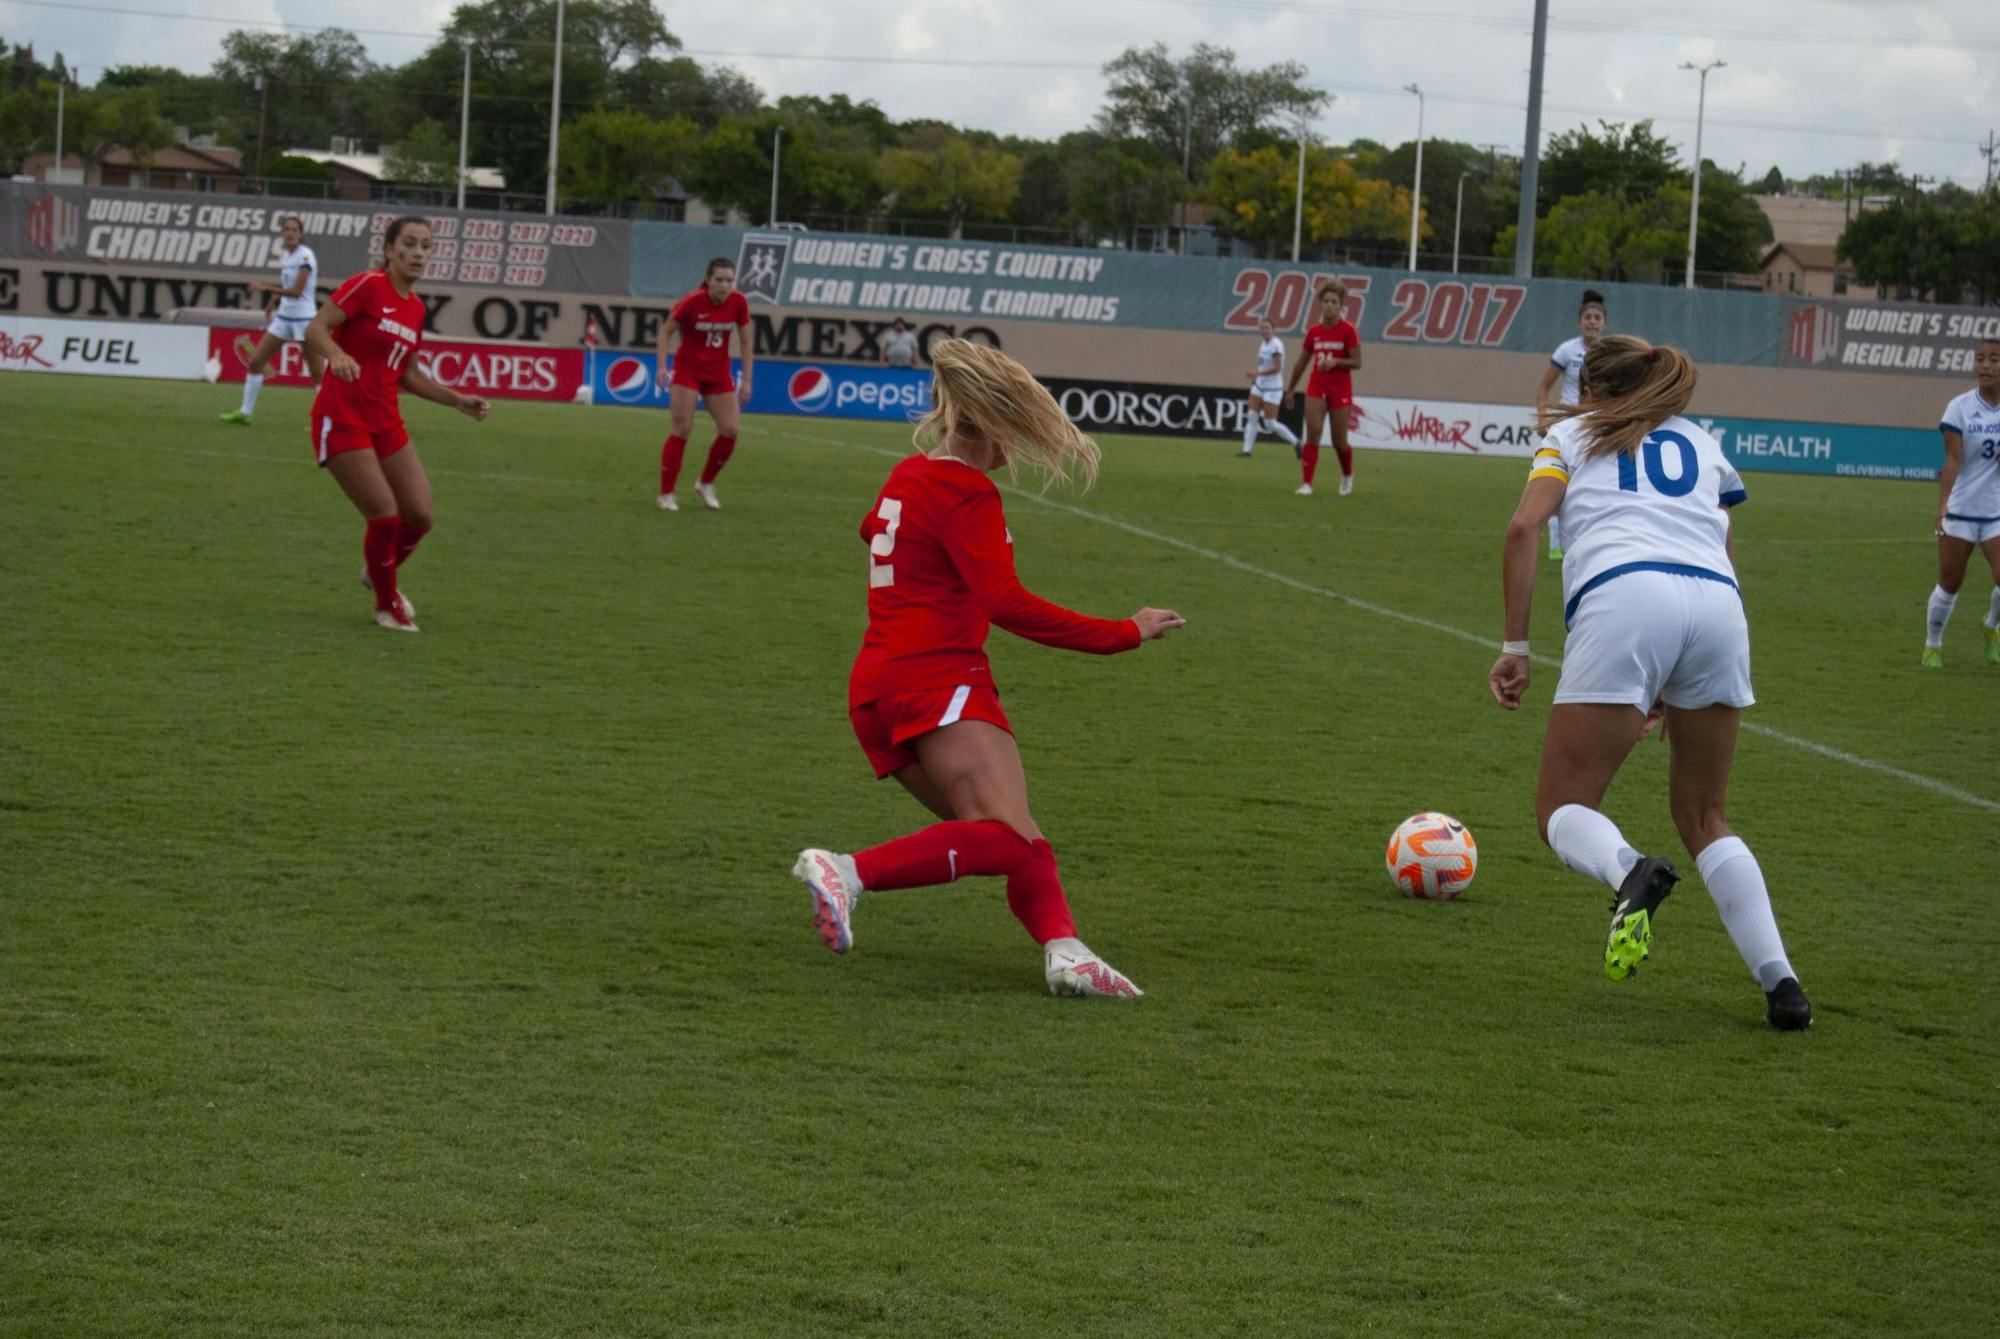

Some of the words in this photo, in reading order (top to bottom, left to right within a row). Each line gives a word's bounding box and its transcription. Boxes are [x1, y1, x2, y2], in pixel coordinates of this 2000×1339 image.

[87, 199, 192, 226] WOMEN'S
[195, 206, 265, 231] CROSS
[271, 210, 368, 237] CUNTRY
[430, 216, 458, 237] 011
[509, 221, 548, 243] 2017
[551, 224, 596, 247] 2020
[86, 225, 283, 269] CHAMPIONS
[793, 238, 909, 270] WOMEN'S
[913, 245, 990, 275] CROSS
[995, 251, 1104, 283] COUNTRY
[790, 277, 855, 305] NCAA
[858, 281, 973, 313] NATIONAL
[980, 288, 1120, 321] CHAMPIONS
[1382, 279, 1527, 346] 2017
[473, 296, 560, 342] OF
[580, 304, 670, 347] NE
[752, 313, 1002, 364] MEXC
[1845, 308, 1943, 336] WOMEN'S
[61, 336, 139, 365] FUEL
[1842, 341, 1935, 370] REGULAR
[1937, 347, 1976, 372] SEA
[836, 380, 925, 412] pepsi
[1481, 424, 1532, 446] CAR
[1735, 433, 1832, 460] HEALTH
[1981, 438, 2000, 460] 3
[1616, 430, 1699, 498] 10
[1836, 463, 1900, 479] DELIVERING
[1903, 467, 1936, 480] MORE
[870, 497, 903, 589] 2
